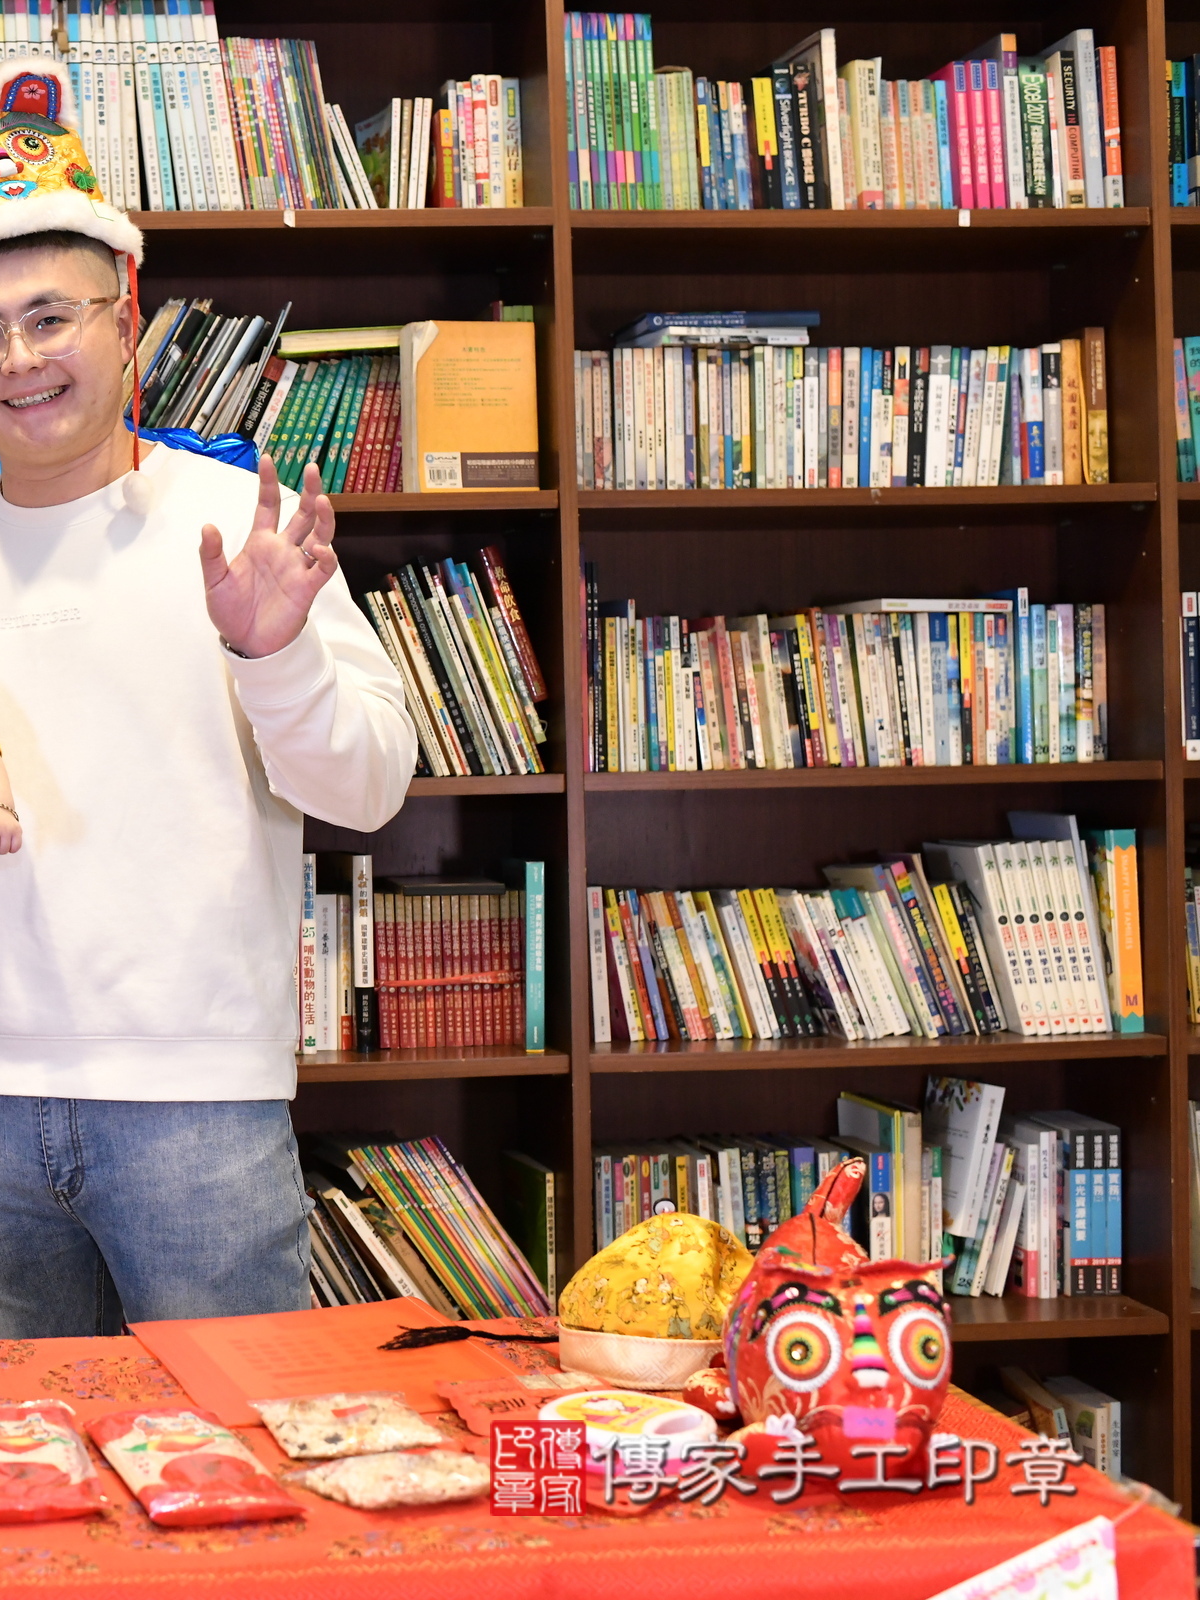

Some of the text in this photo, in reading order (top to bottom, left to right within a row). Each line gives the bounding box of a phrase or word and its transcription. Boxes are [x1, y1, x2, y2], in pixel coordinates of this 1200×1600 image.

[1021, 73, 1047, 104] Excel
[779, 99, 793, 150] Silverlight
[1026, 104, 1046, 125] 2007
[1063, 65, 1082, 181] SECURITY IN COMPUTING
[494, 565, 521, 623] 救命飲食
[302, 926, 316, 939] 25
[1007, 950, 1022, 985] 科學百科
[1023, 950, 1037, 985] 科學百科
[1038, 949, 1052, 984] 科學百科
[1053, 946, 1067, 981] 科學百科
[1067, 947, 1082, 982] 科學百科
[1082, 946, 1096, 981] 科學百科
[303, 945, 316, 1026] 哺乳動物的生活
[1020, 1000, 1029, 1012] 6
[1034, 1000, 1043, 1012] 5
[1050, 1000, 1058, 1011] 4
[1079, 999, 1087, 1010] 2
[1094, 998, 1100, 1009] 1
[1075, 1173, 1087, 1242] 觀光資源概要
[1074, 1258, 1088, 1266] 2019
[1091, 1258, 1106, 1266] 2019
[1107, 1258, 1121, 1266] 2019
